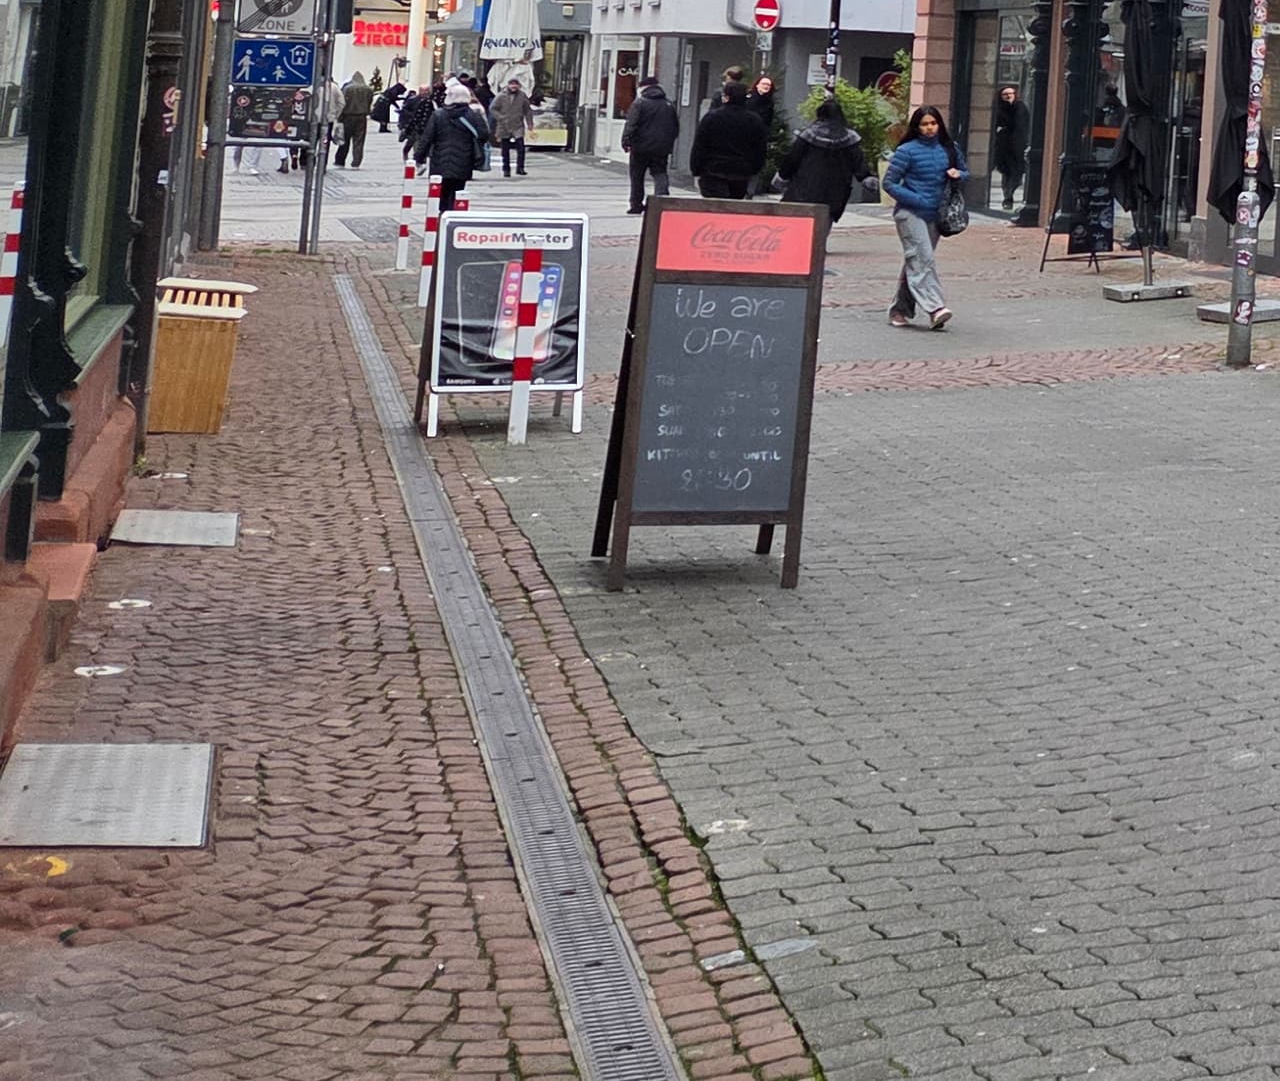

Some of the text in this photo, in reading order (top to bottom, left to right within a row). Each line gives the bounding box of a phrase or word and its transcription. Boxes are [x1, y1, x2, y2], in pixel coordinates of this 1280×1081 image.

[258, 20, 296, 32] ZONE
[456, 231, 569, 245] RepairMter
[730, 296, 785, 318] are
[743, 451, 781, 461] UNTIL
